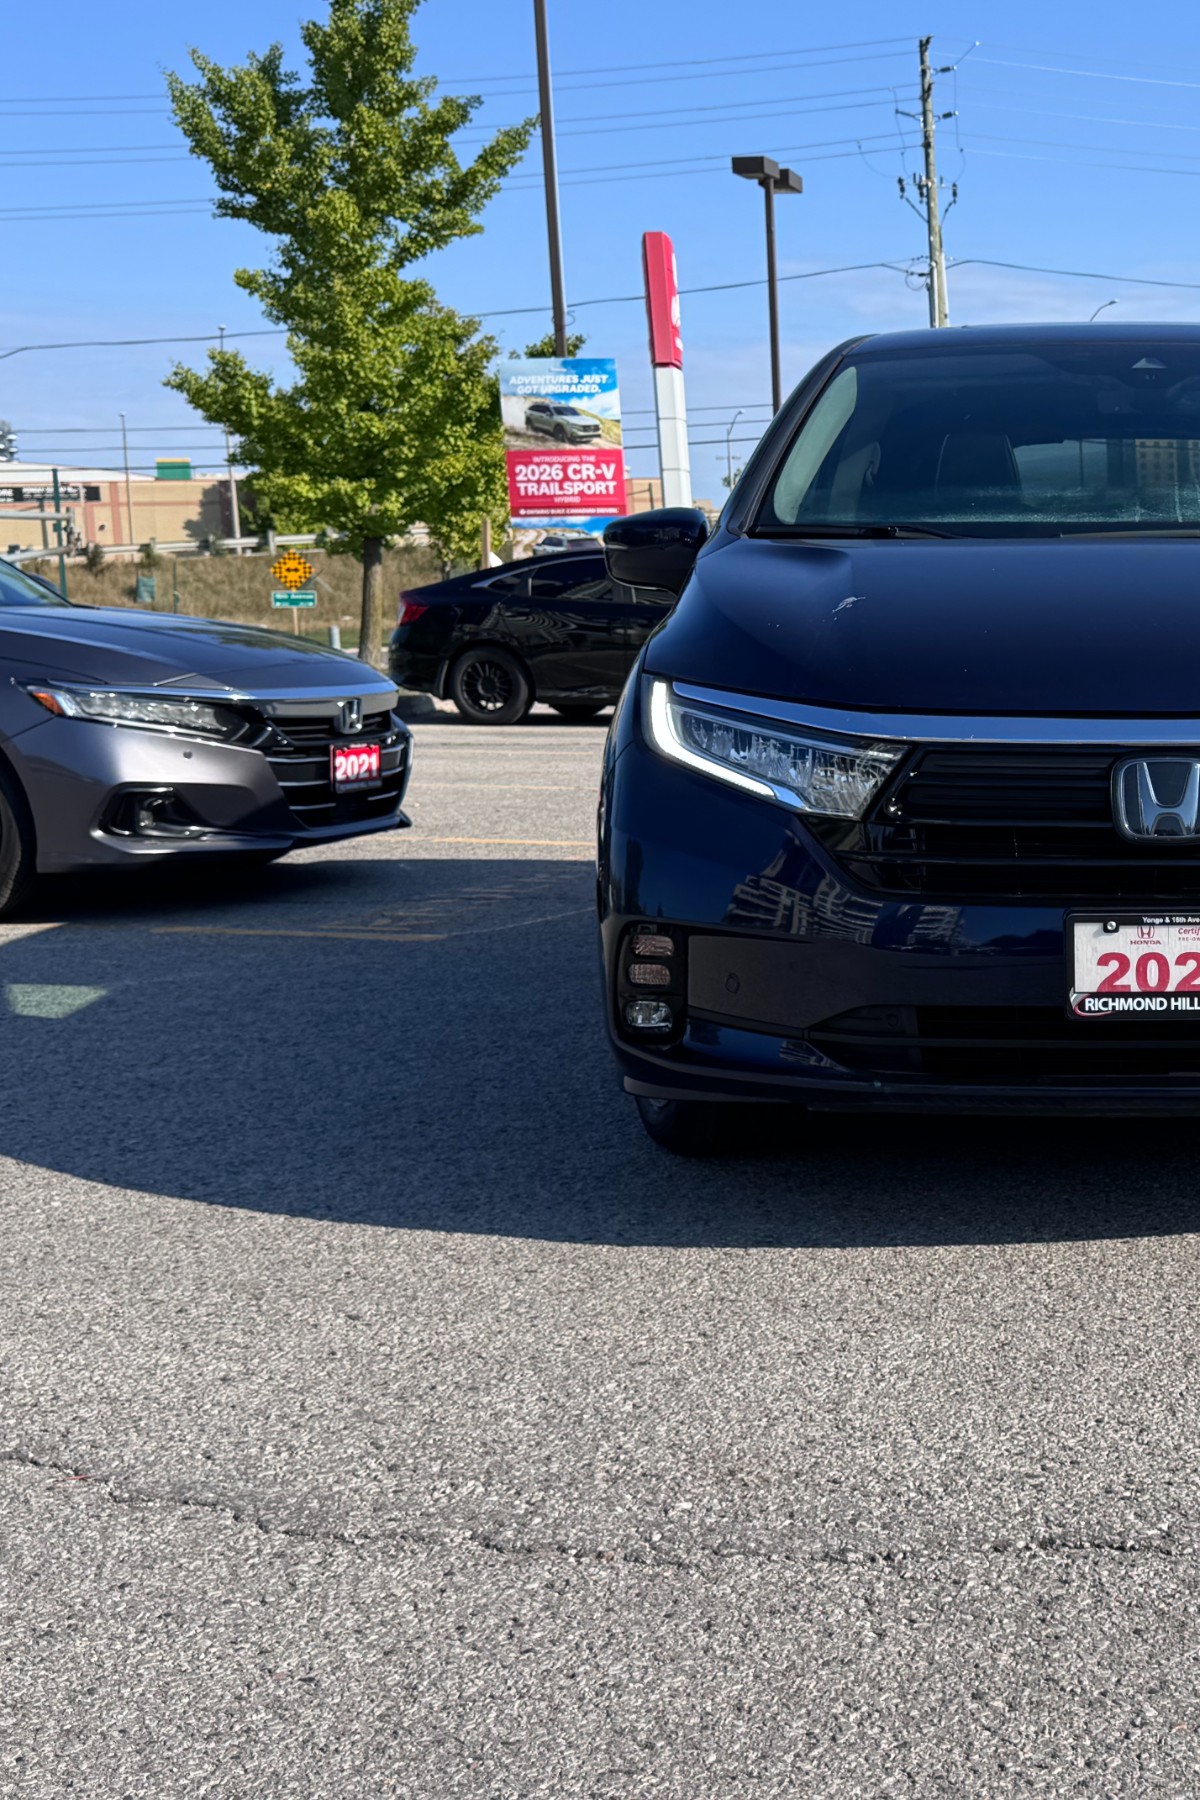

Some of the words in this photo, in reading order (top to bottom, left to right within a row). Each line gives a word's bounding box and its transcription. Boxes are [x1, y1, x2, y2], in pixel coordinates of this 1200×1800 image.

[509, 374, 579, 385] ADVENTURES
[580, 374, 609, 384] JUST
[516, 384, 538, 394] GOT
[540, 384, 602, 394] UPGRADED.
[532, 455, 580, 463] INTRODUCING
[515, 464, 564, 481] 2026
[567, 463, 616, 480] CR-V
[516, 481, 617, 496] TRAILSPORT
[335, 752, 378, 781] 2021
[1142, 916, 1164, 925] Yonge
[1085, 997, 1168, 1011] RICHMOND
